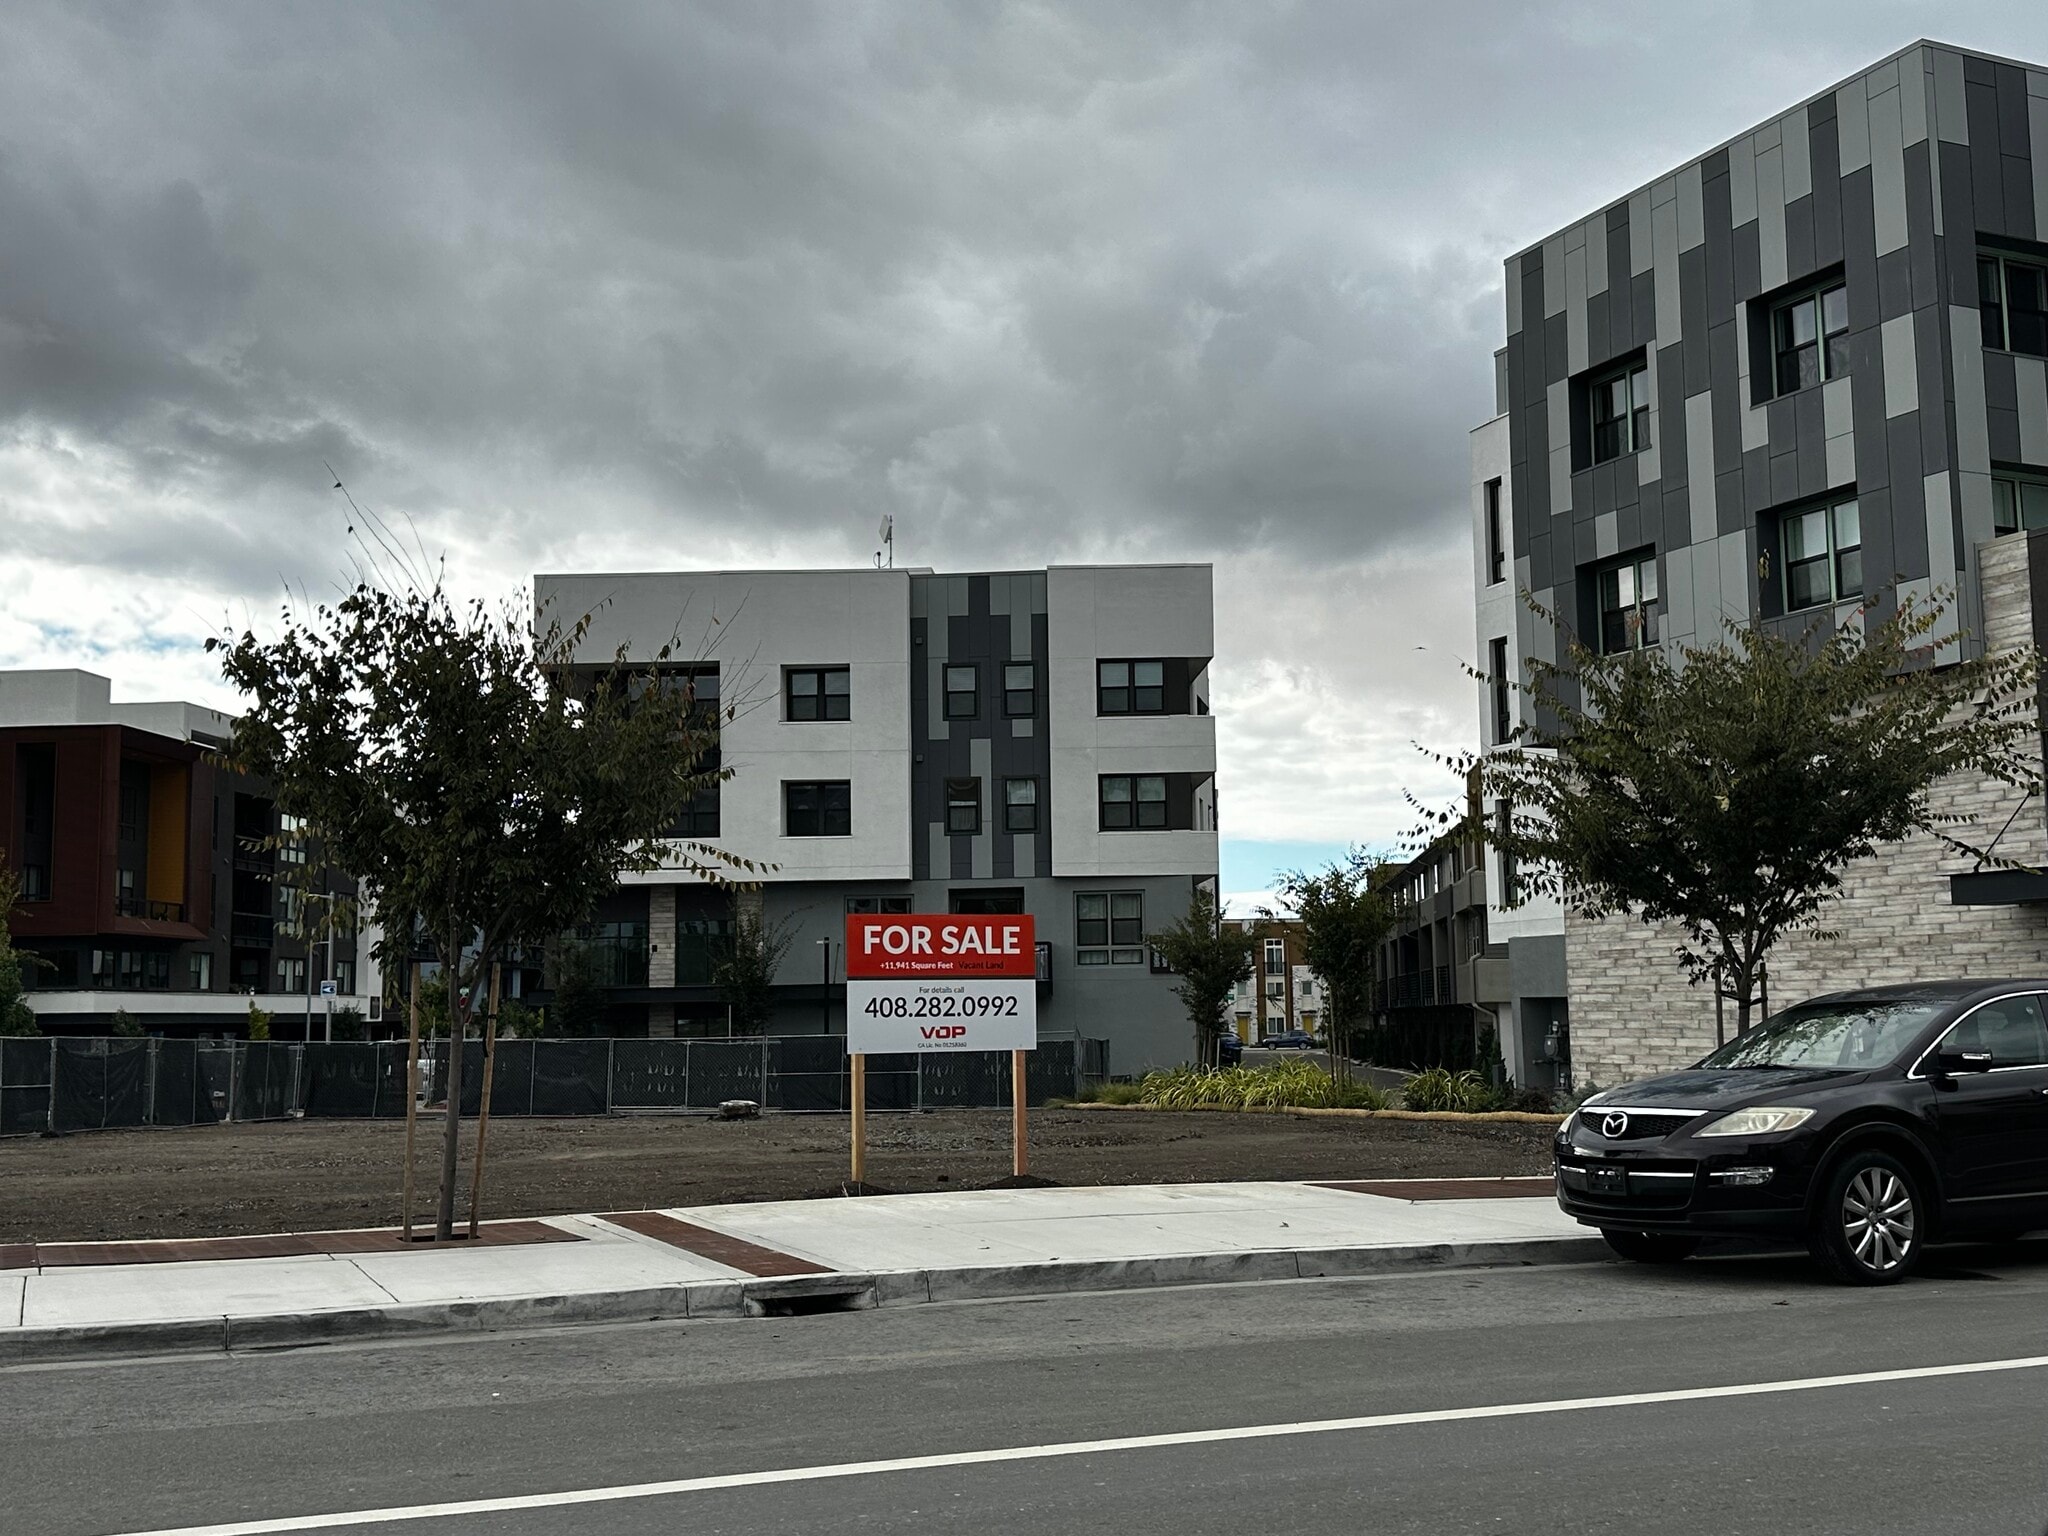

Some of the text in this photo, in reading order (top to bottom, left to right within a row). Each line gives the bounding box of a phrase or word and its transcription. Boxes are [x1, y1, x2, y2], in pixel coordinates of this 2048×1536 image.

[864, 925, 1020, 955] FOR SALE
[911, 961, 936, 970] Square
[937, 961, 954, 970] Feet
[959, 961, 984, 970] Vacant
[985, 961, 1004, 970] Land
[864, 996, 1018, 1018] 408.282.0992
